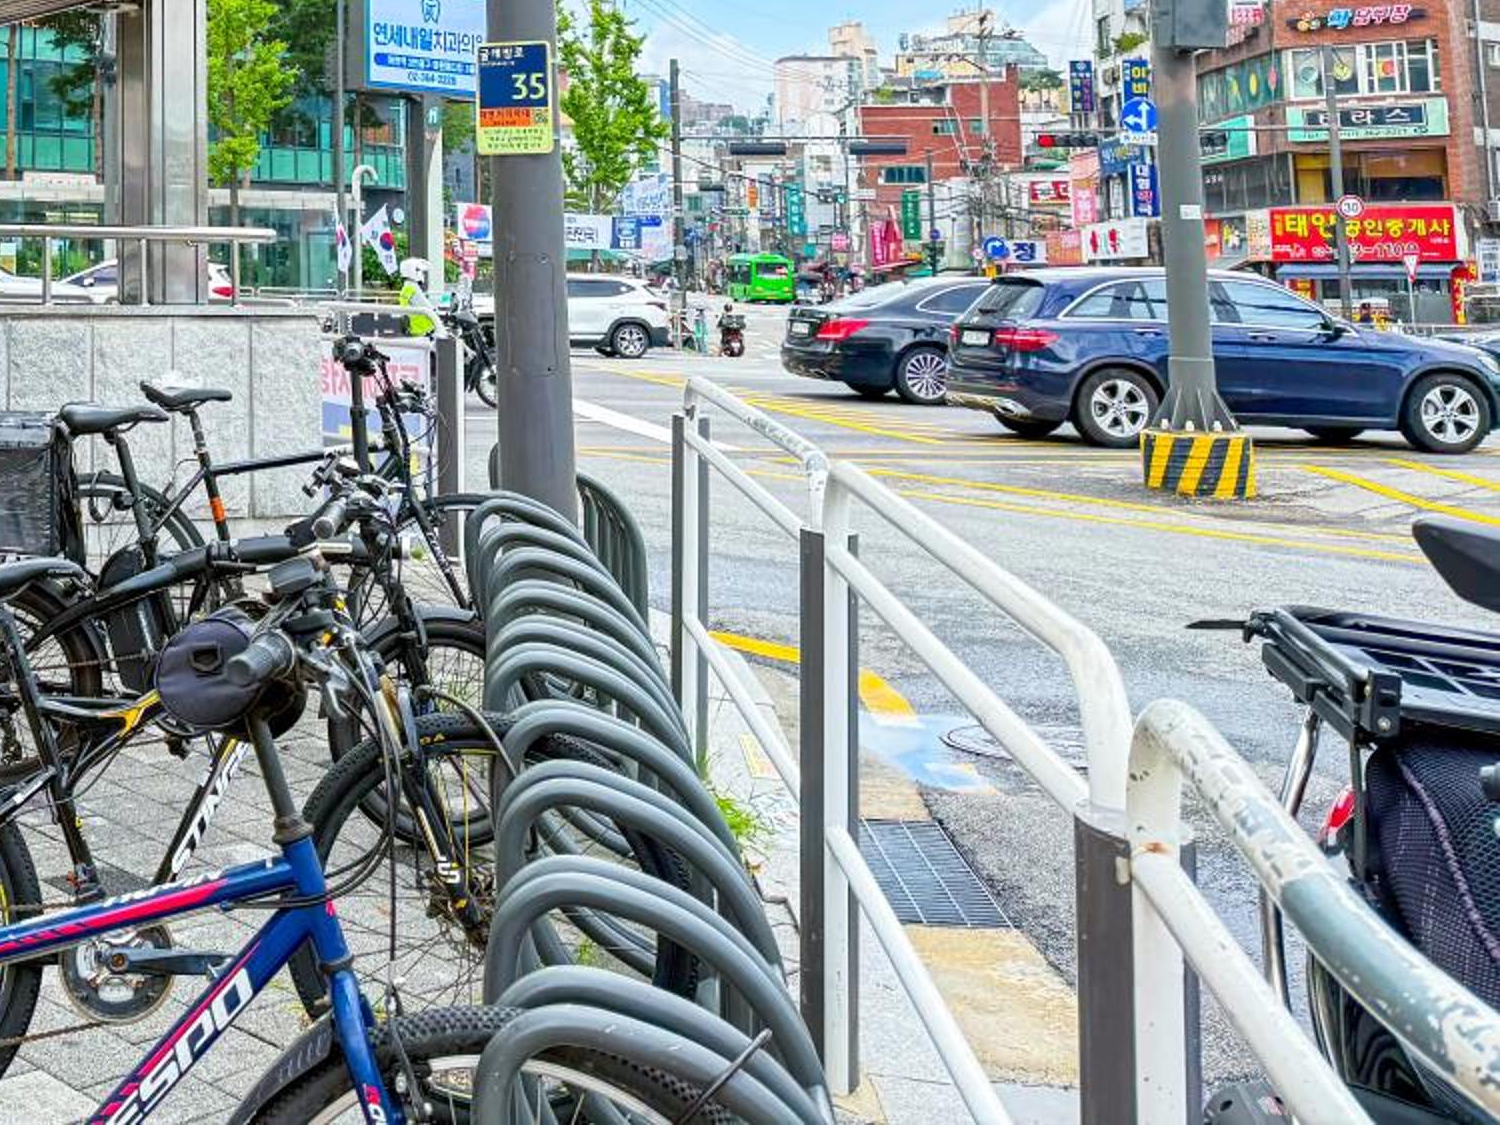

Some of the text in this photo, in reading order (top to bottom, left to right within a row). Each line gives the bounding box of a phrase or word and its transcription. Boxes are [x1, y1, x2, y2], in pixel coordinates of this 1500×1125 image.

[511, 73, 546, 100] 35
[1343, 201, 1360, 213] 30
[1344, 217, 1450, 239] 공인중개사
